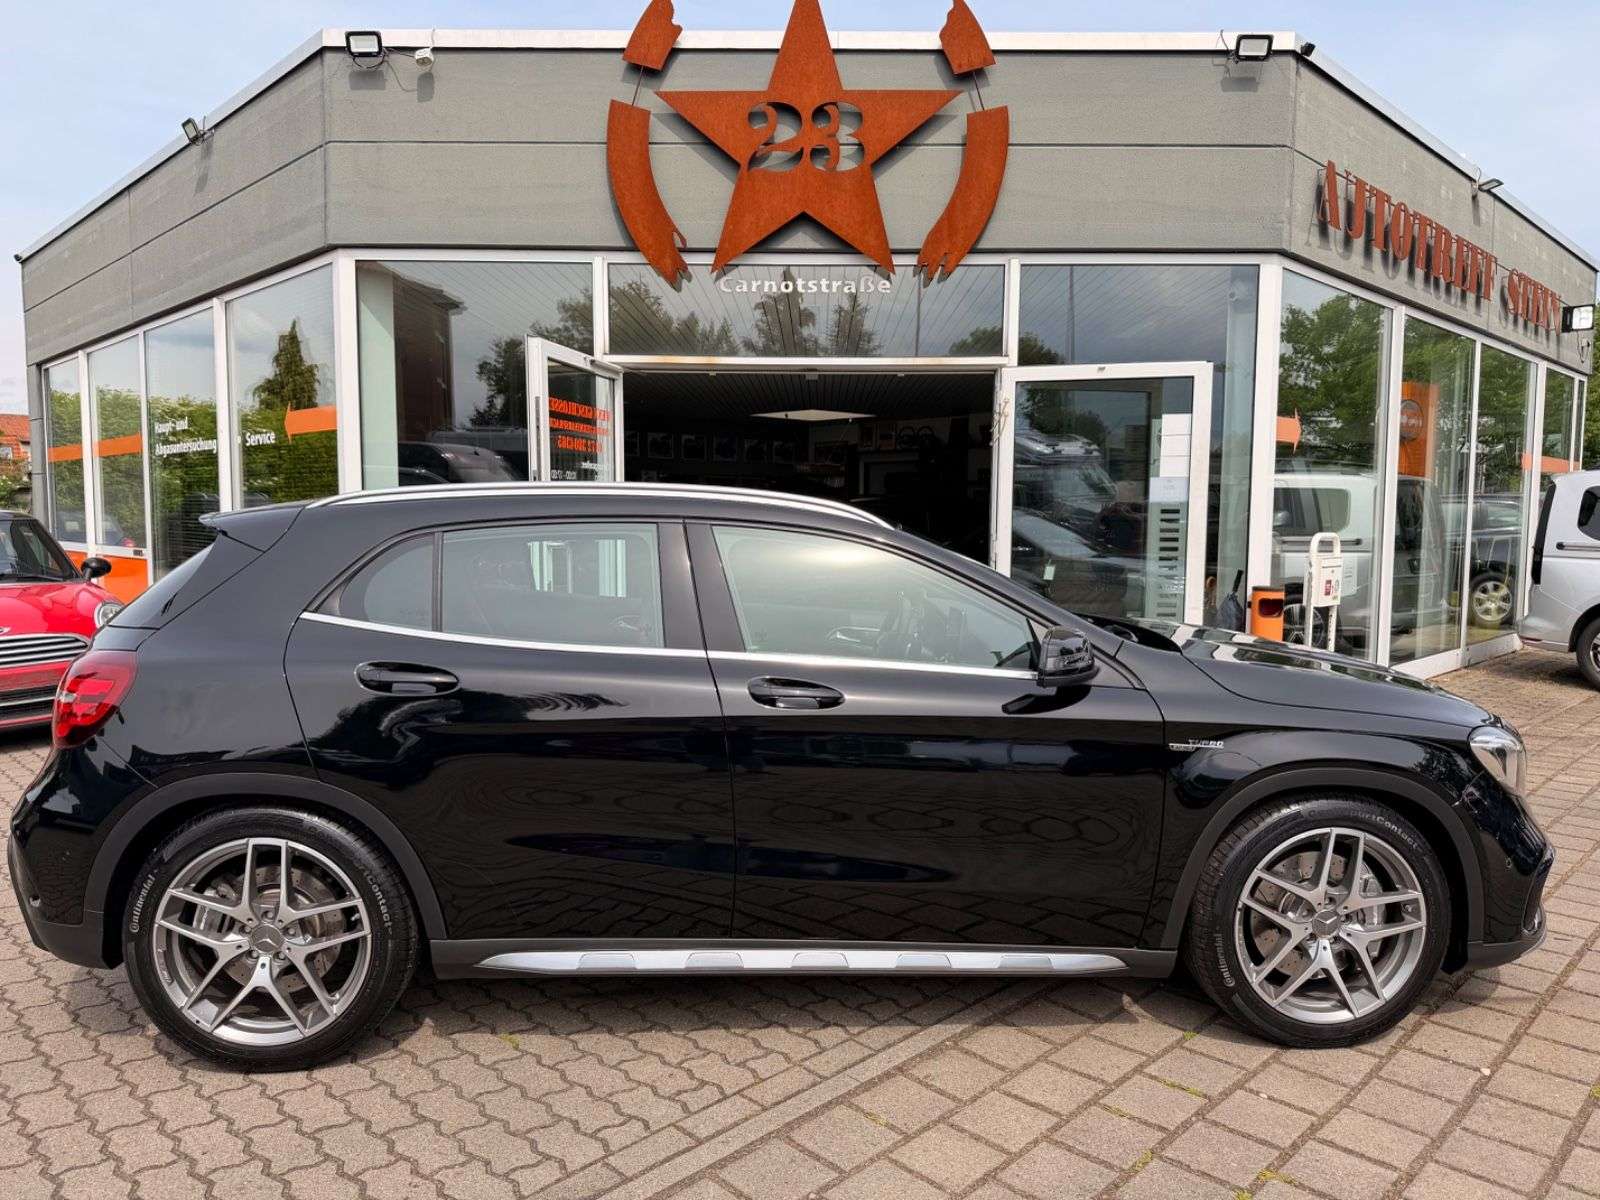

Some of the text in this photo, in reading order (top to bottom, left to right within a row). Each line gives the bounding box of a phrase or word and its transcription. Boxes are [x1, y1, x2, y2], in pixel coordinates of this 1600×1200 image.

[746, 101, 866, 173] 23
[718, 276, 892, 293] Carnotstraße
[245, 432, 276, 447] Service
[129, 874, 157, 934] Continental
